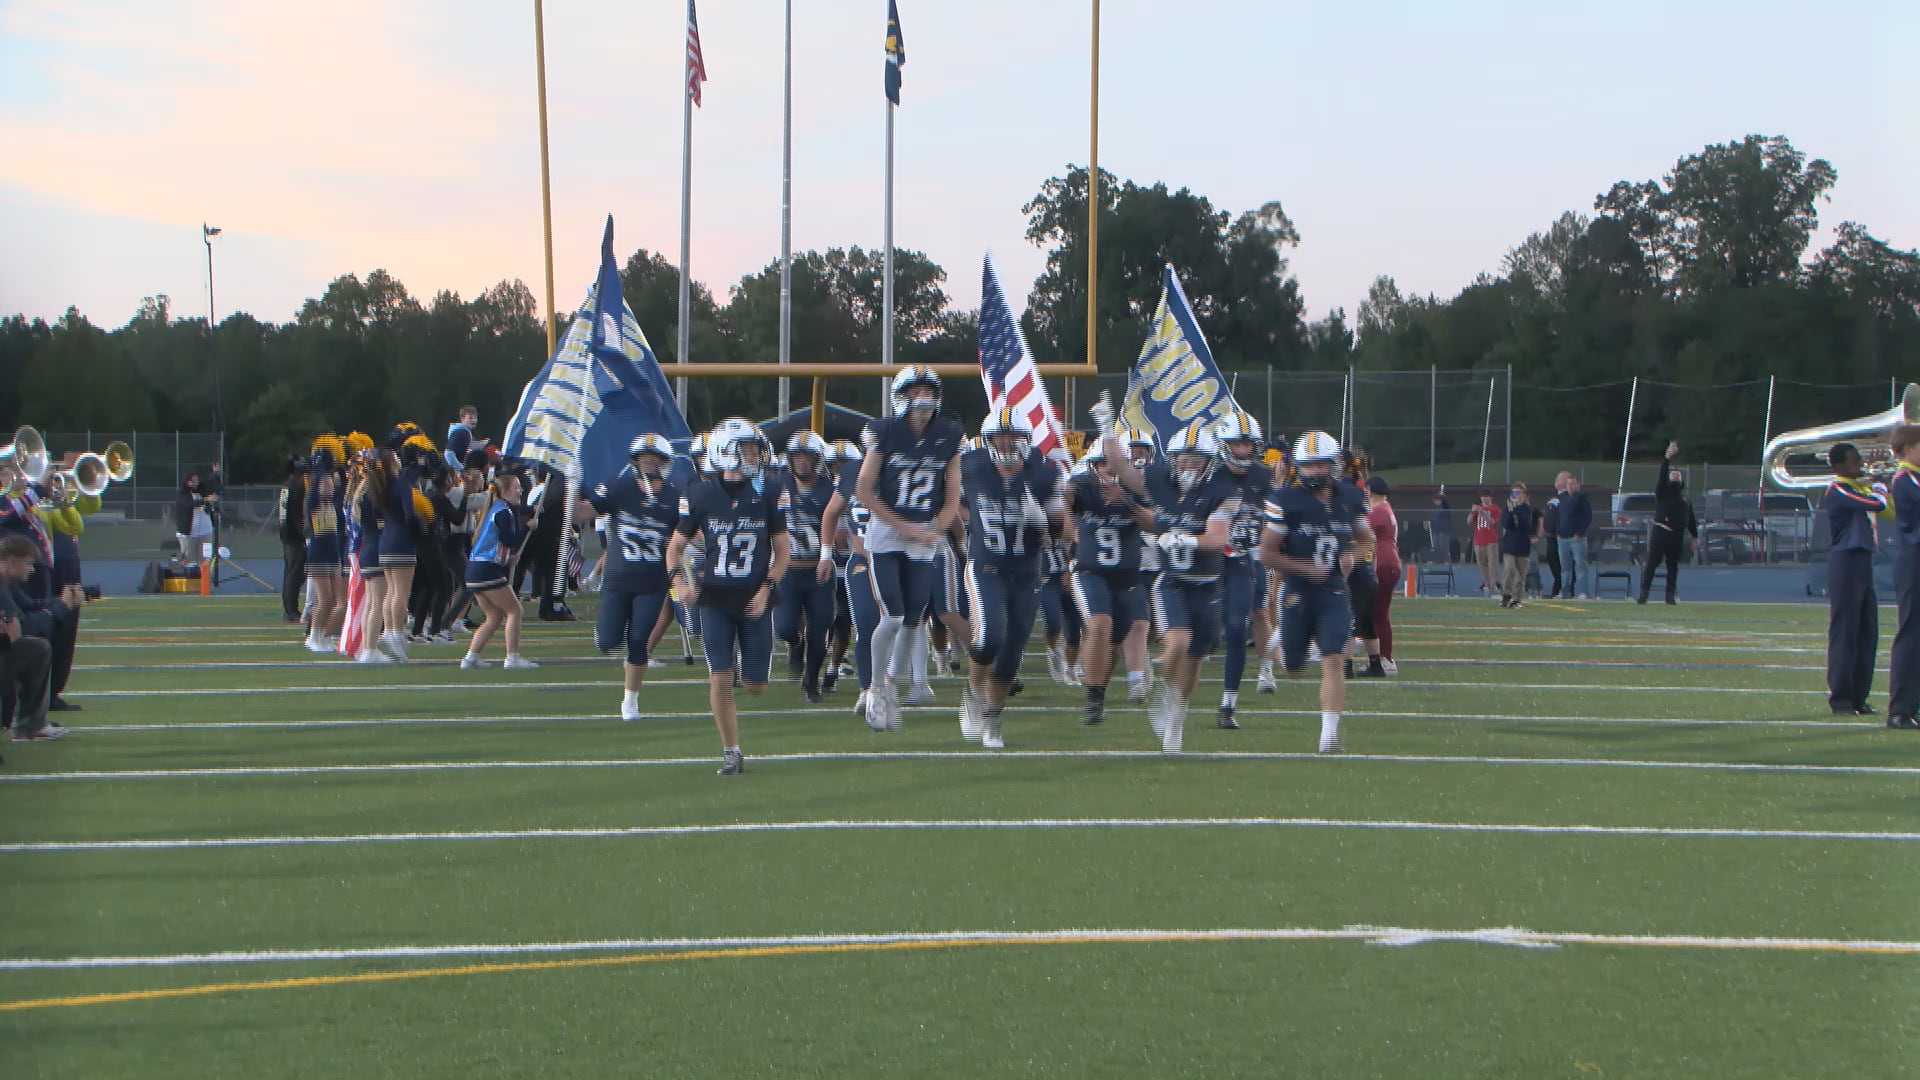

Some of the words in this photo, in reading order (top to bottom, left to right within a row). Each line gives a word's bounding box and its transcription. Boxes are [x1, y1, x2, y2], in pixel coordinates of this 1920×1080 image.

[895, 468, 936, 511] 12
[617, 523, 664, 562] 53
[979, 509, 1025, 556] 57
[1094, 527, 1121, 566] 9
[713, 533, 757, 577] 13
